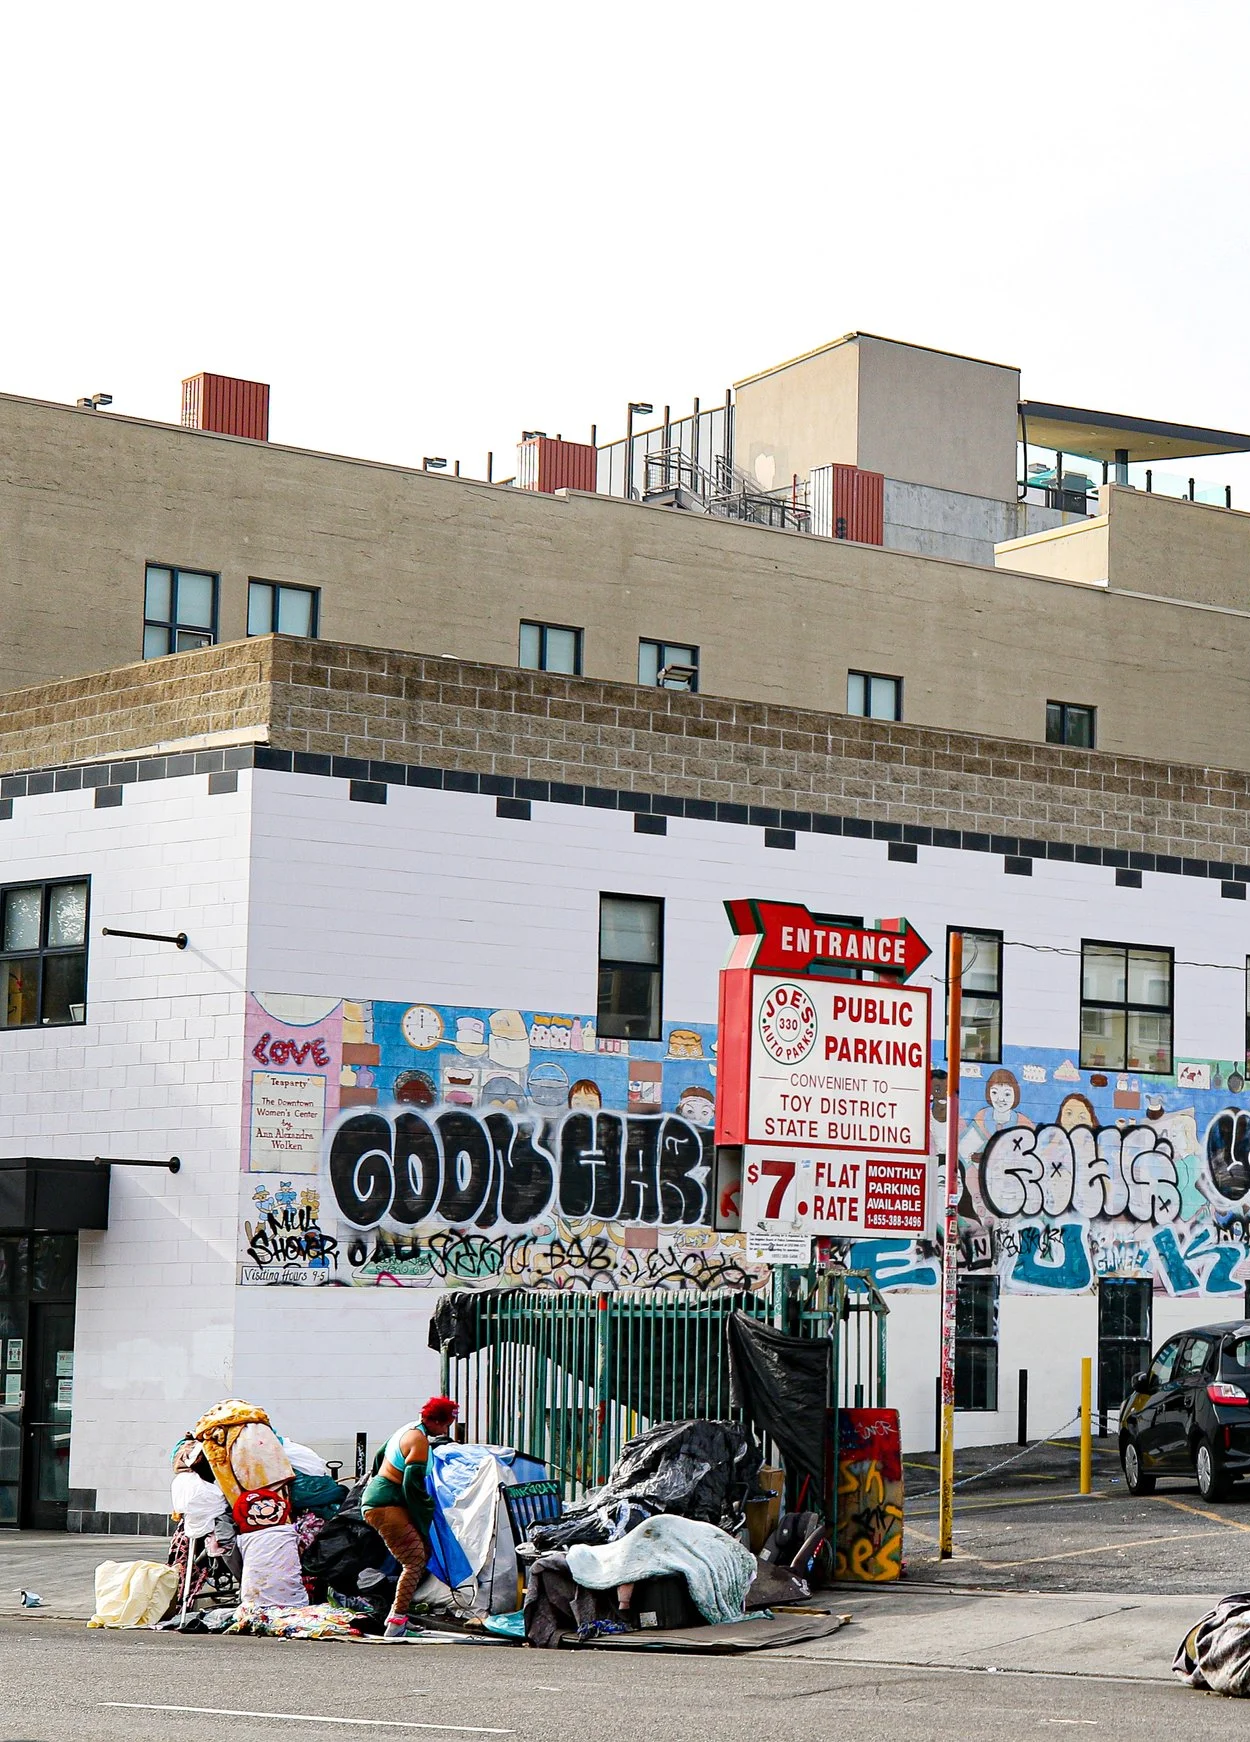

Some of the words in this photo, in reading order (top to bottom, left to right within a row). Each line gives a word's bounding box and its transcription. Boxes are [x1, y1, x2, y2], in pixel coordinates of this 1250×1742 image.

[781, 926, 906, 964] ENTRANCE
[765, 988, 814, 1024] JOE'S
[832, 995, 913, 1028] PUBLIC
[779, 1017, 798, 1031] 330
[252, 1032, 330, 1067] LOVE
[762, 1024, 784, 1057] AUTO
[785, 1028, 814, 1060] PARKS
[824, 1035, 923, 1068] PARKING
[790, 1073, 868, 1092] CONVENIENT
[873, 1080, 889, 1094] TO
[261, 1097, 275, 1106] The
[277, 1098, 314, 1107] Downtown
[780, 1094, 813, 1113] TOY
[820, 1097, 898, 1119] DISTRICT
[256, 1108, 291, 1118] Women's
[294, 1110, 318, 1118] Center
[256, 1128, 274, 1138] Ann
[765, 1117, 819, 1138] STATE
[828, 1122, 912, 1145] BUILDING
[271, 1139, 303, 1150] Wolken
[814, 1161, 861, 1189] FLAT
[868, 1165, 923, 1180] MONTHLY
[868, 1182, 921, 1196] PARKING
[813, 1195, 859, 1222] RATE
[866, 1198, 922, 1212] AVAILABLE
[867, 1213, 922, 1228] 1-855-388-3496
[244, 1268, 280, 1282] Visiting
[282, 1269, 308, 1281] Hours
[312, 1271, 326, 1281] 9-5
